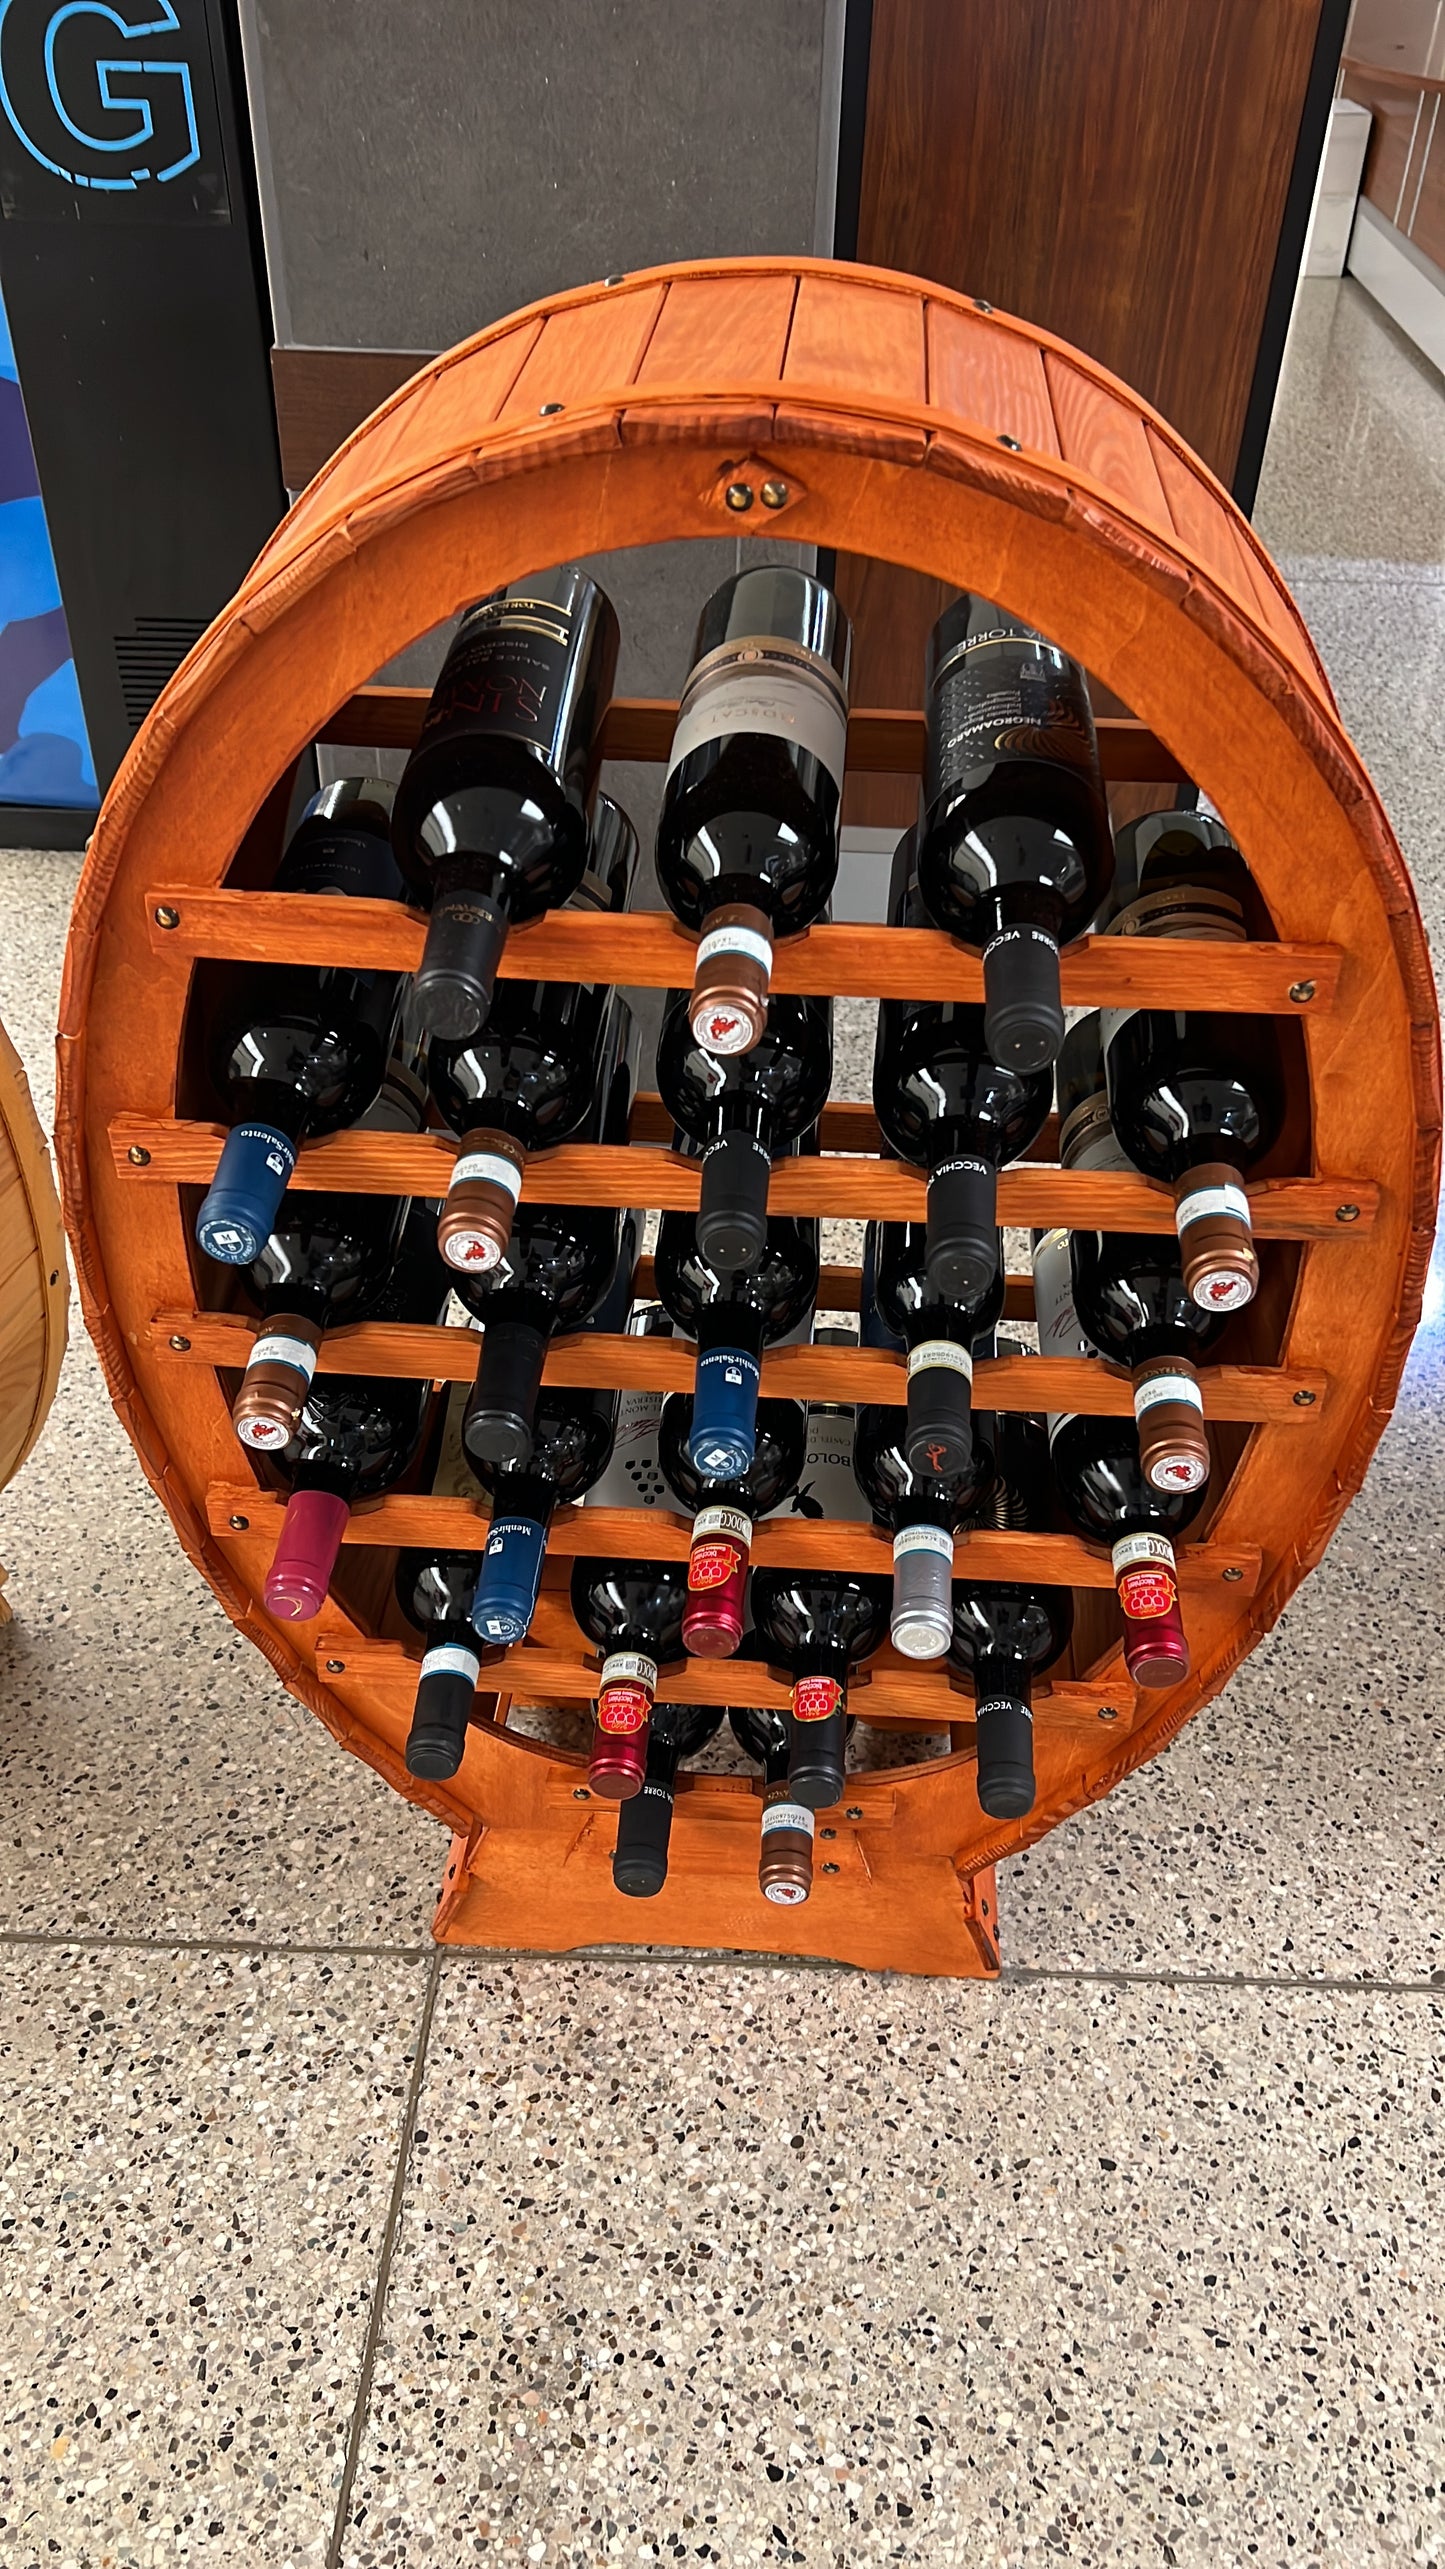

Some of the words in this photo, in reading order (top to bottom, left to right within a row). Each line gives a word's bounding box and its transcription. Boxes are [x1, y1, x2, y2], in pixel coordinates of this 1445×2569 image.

[0, 0, 201, 190] G
[946, 715, 1042, 749] NEGROAMARO
[936, 1161, 987, 1176] VECCHIA
[643, 1786, 666, 1799] TORRE
